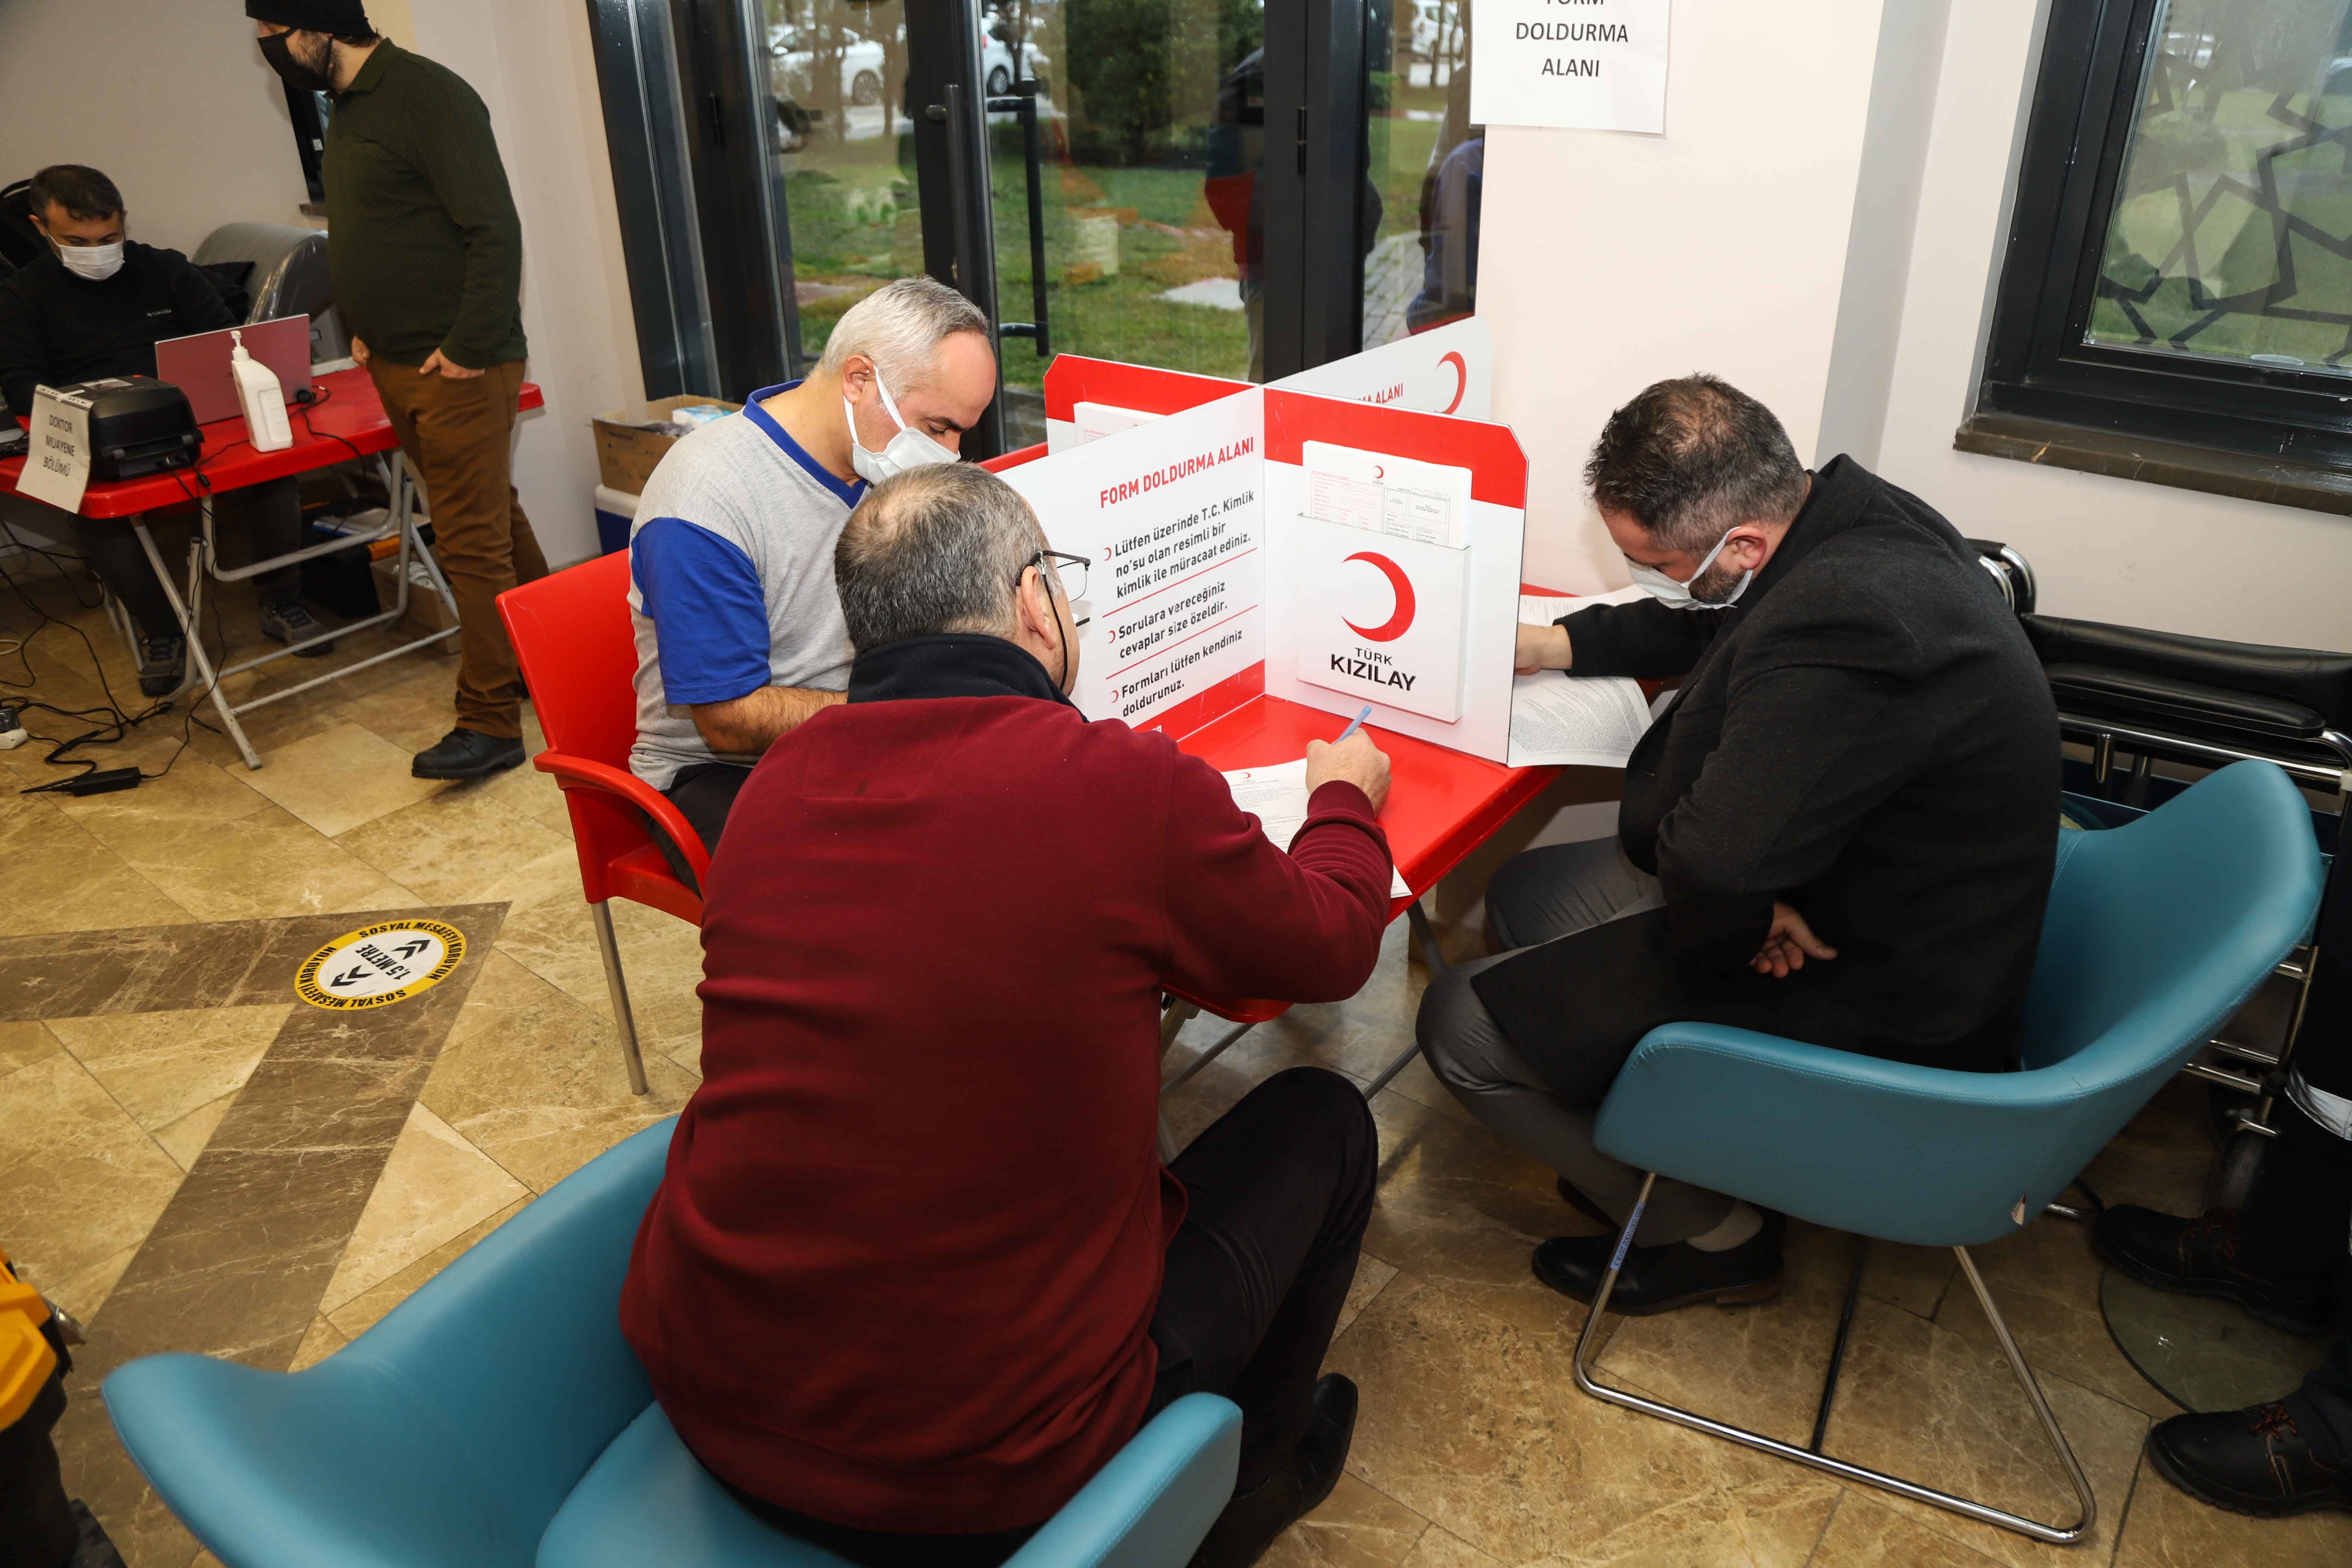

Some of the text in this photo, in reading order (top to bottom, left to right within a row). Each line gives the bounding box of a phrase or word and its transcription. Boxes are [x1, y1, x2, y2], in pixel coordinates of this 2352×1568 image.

[1517, 23, 1628, 42] DOLDURMA
[1542, 59, 1599, 77] ALANI
[1375, 383, 1404, 404] ALANI
[49, 415, 73, 433] DOKTOR
[46, 435, 75, 456] MUAYENE
[43, 455, 71, 476] BÖLÜMÜ
[1101, 437, 1253, 508] FORM DOLDURMA ALANI
[1116, 491, 1253, 556] Lütfen üzerinde T.C. Kimlik
[1148, 547, 1170, 563] olan
[1174, 528, 1209, 553] resimli
[1213, 523, 1225, 537] bir
[1117, 534, 1250, 598] kimlik ile müracaat ediniz.
[1119, 582, 1225, 639] Sorulara vereceğiniz
[1120, 601, 1227, 658] cevaplar size özeldir.
[1122, 631, 1242, 698] Formları lütfen kendiniz
[1331, 654, 1416, 691] KIZILAY
[1355, 648, 1392, 665] TÜRK
[1123, 680, 1184, 717] doldurunuz.
[299, 946, 338, 984] KORUYUN
[355, 944, 411, 980] 1,5 METRE
[358, 922, 463, 980] SOSYAL MESAFEYİ KORUYUN
[350, 990, 406, 1007] SOSYAL
